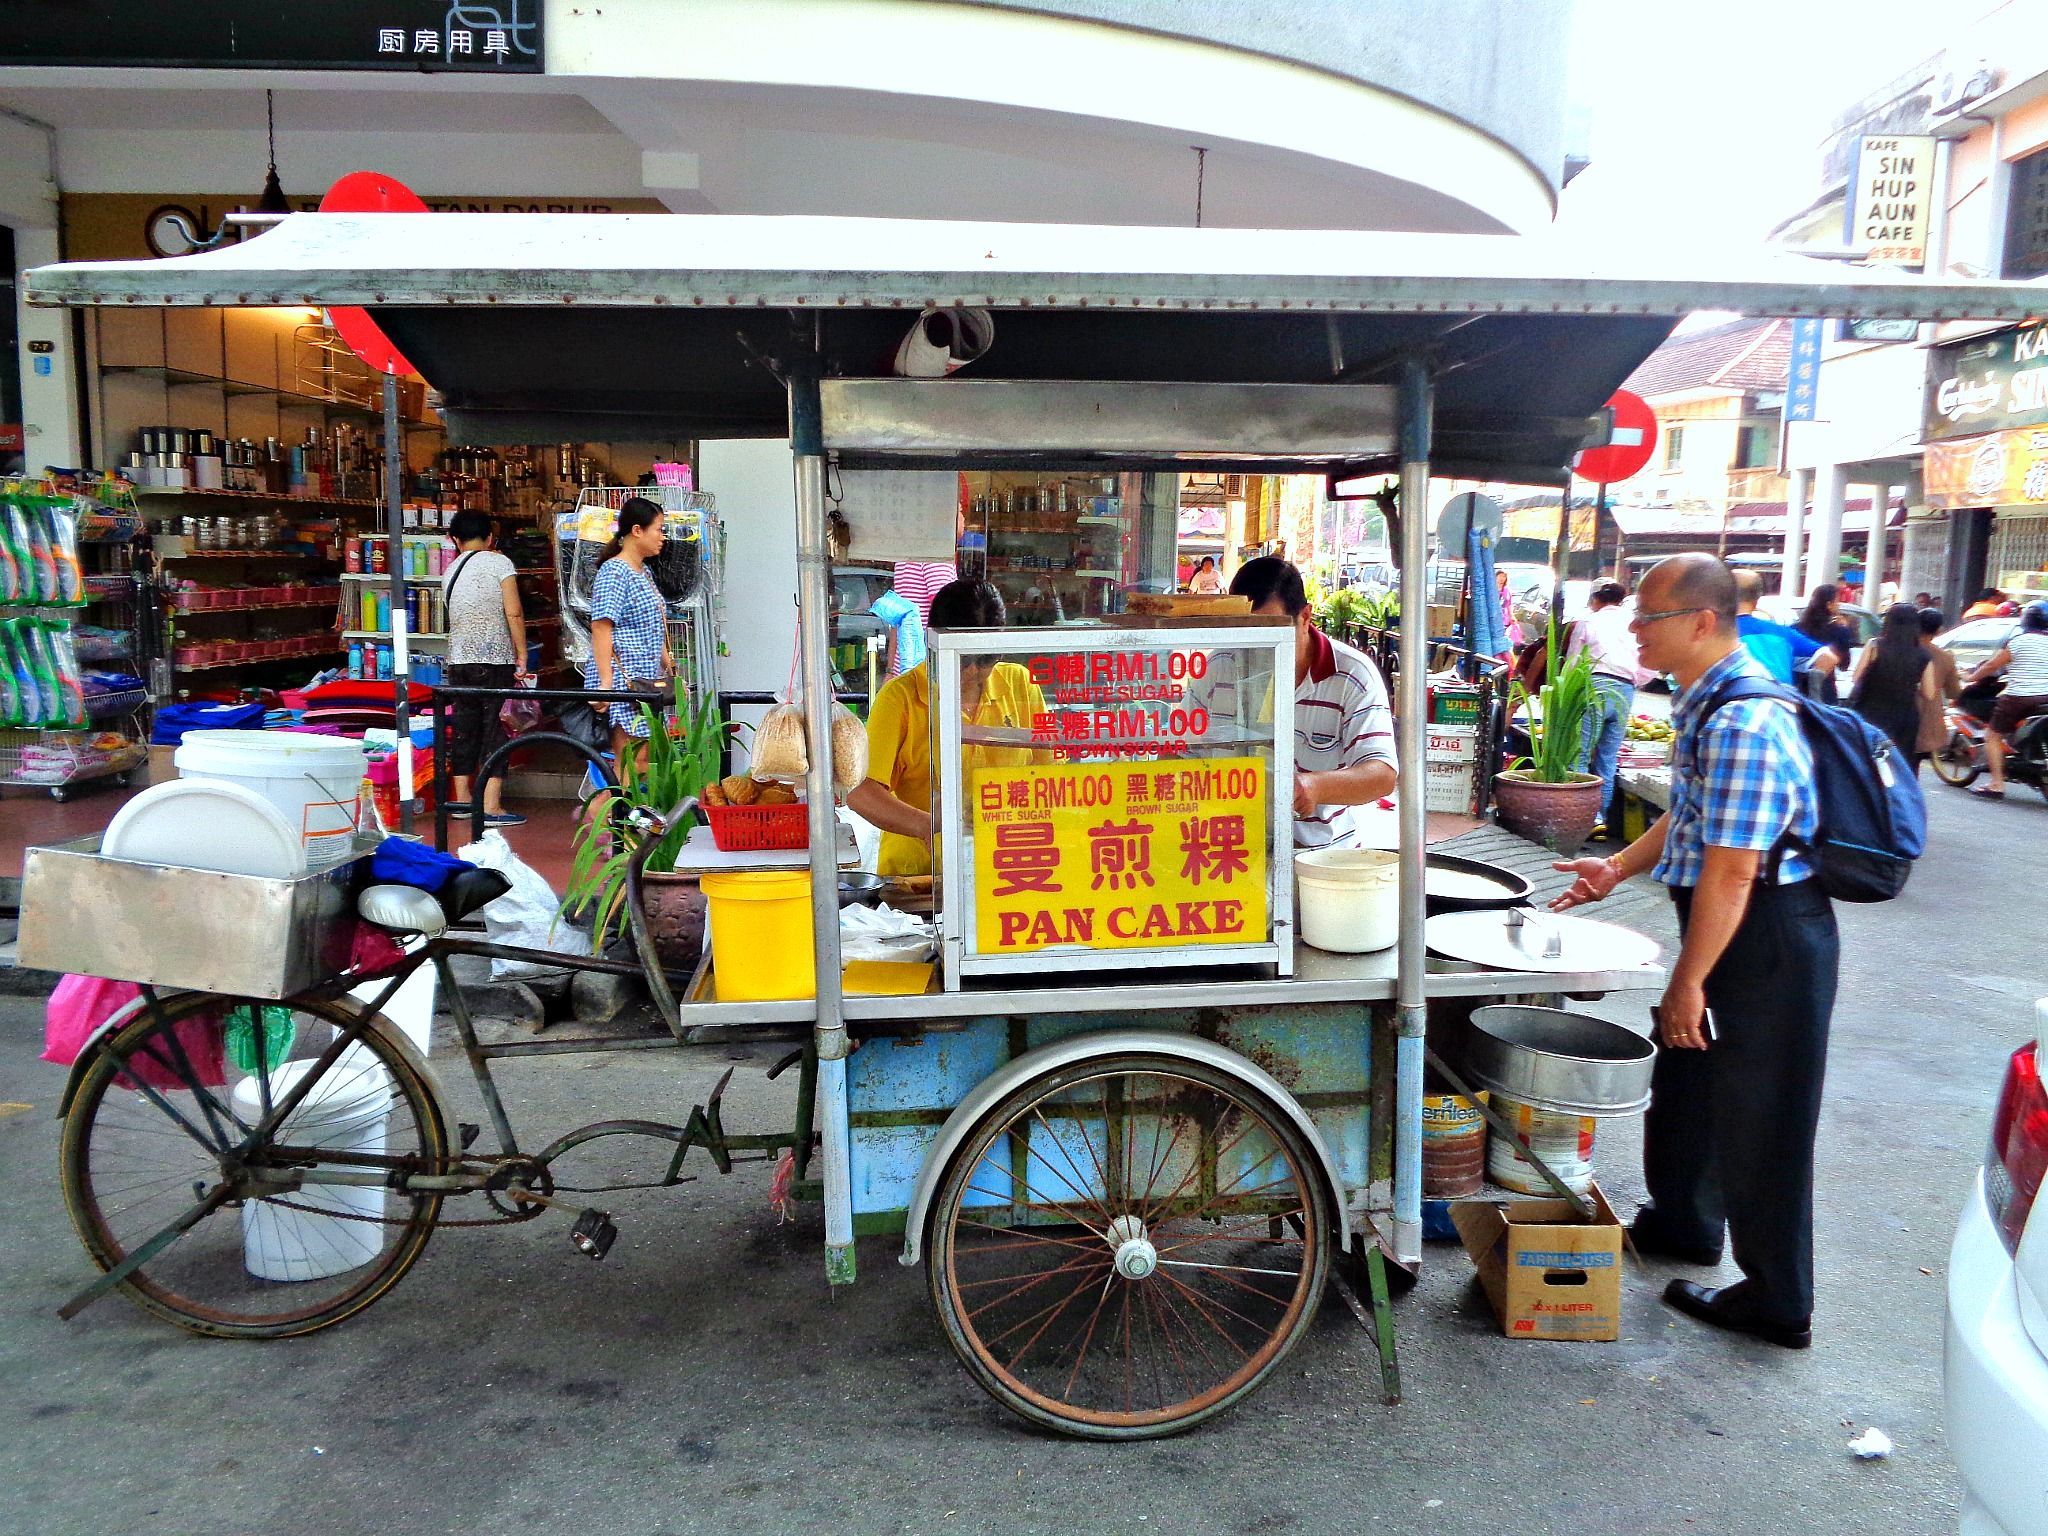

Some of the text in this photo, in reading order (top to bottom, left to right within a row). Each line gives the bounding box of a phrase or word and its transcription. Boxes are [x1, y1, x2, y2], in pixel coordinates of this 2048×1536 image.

[378, 29, 511, 55] 厨房用具
[1866, 141, 1898, 151] KAFE
[1880, 157, 1915, 175] SIN
[1871, 179, 1916, 198] HUP
[1868, 203, 1916, 221] AUN
[1866, 226, 1914, 241] CAFE
[1054, 684, 1183, 705] WHITE SUGAR
[1053, 740, 1188, 760] BROWN SUGAR
[982, 809, 1052, 822] WHITE SUGAR
[1126, 802, 1199, 815] BROWN SUGAR
[998, 899, 1245, 946] PAN CAKE
[1561, 1303, 1594, 1312] LITER
